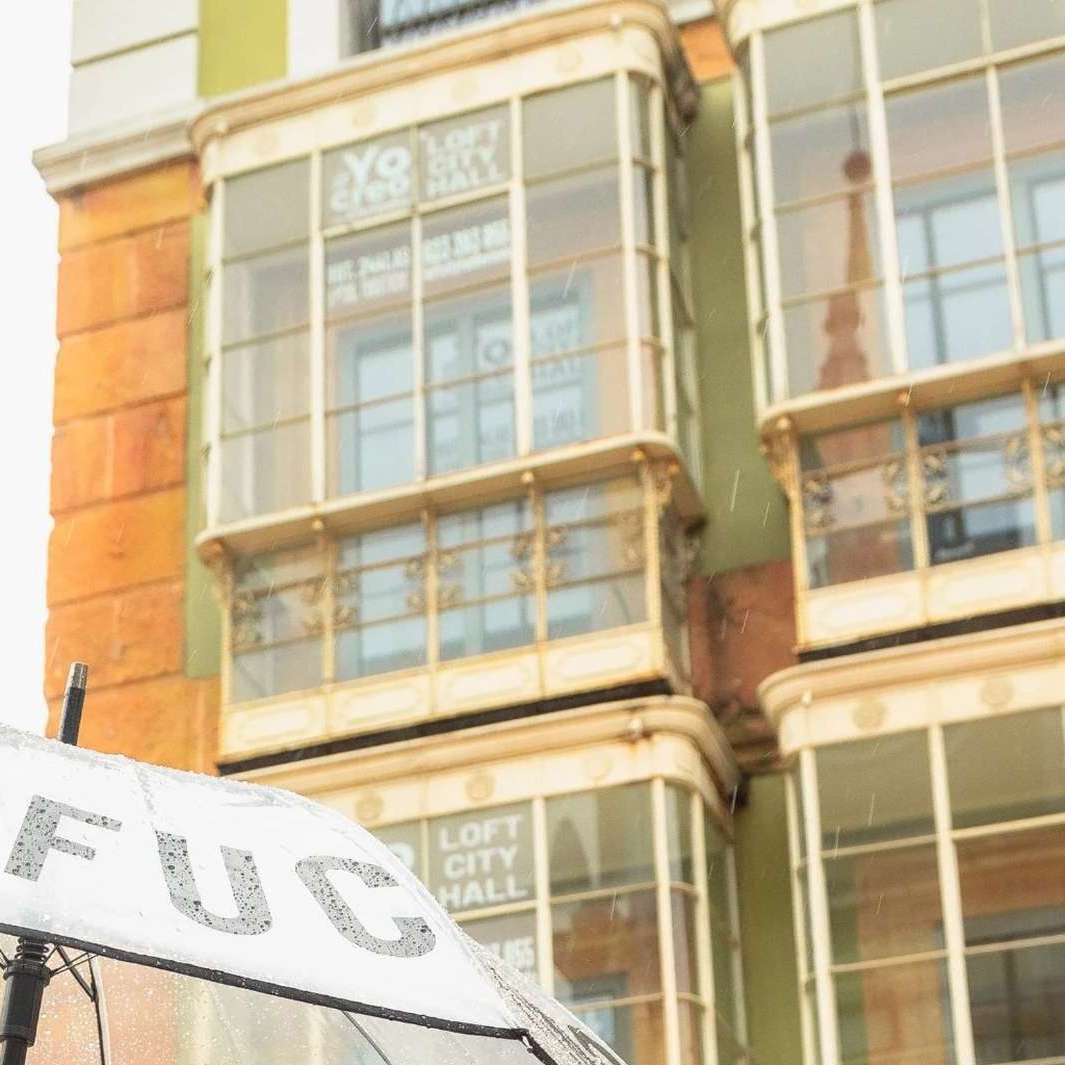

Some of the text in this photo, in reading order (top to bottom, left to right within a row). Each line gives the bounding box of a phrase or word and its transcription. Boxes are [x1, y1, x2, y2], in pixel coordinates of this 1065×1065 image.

[441, 813, 522, 850] LOFT
[445, 844, 518, 880] CITY
[438, 875, 528, 909] HALL
